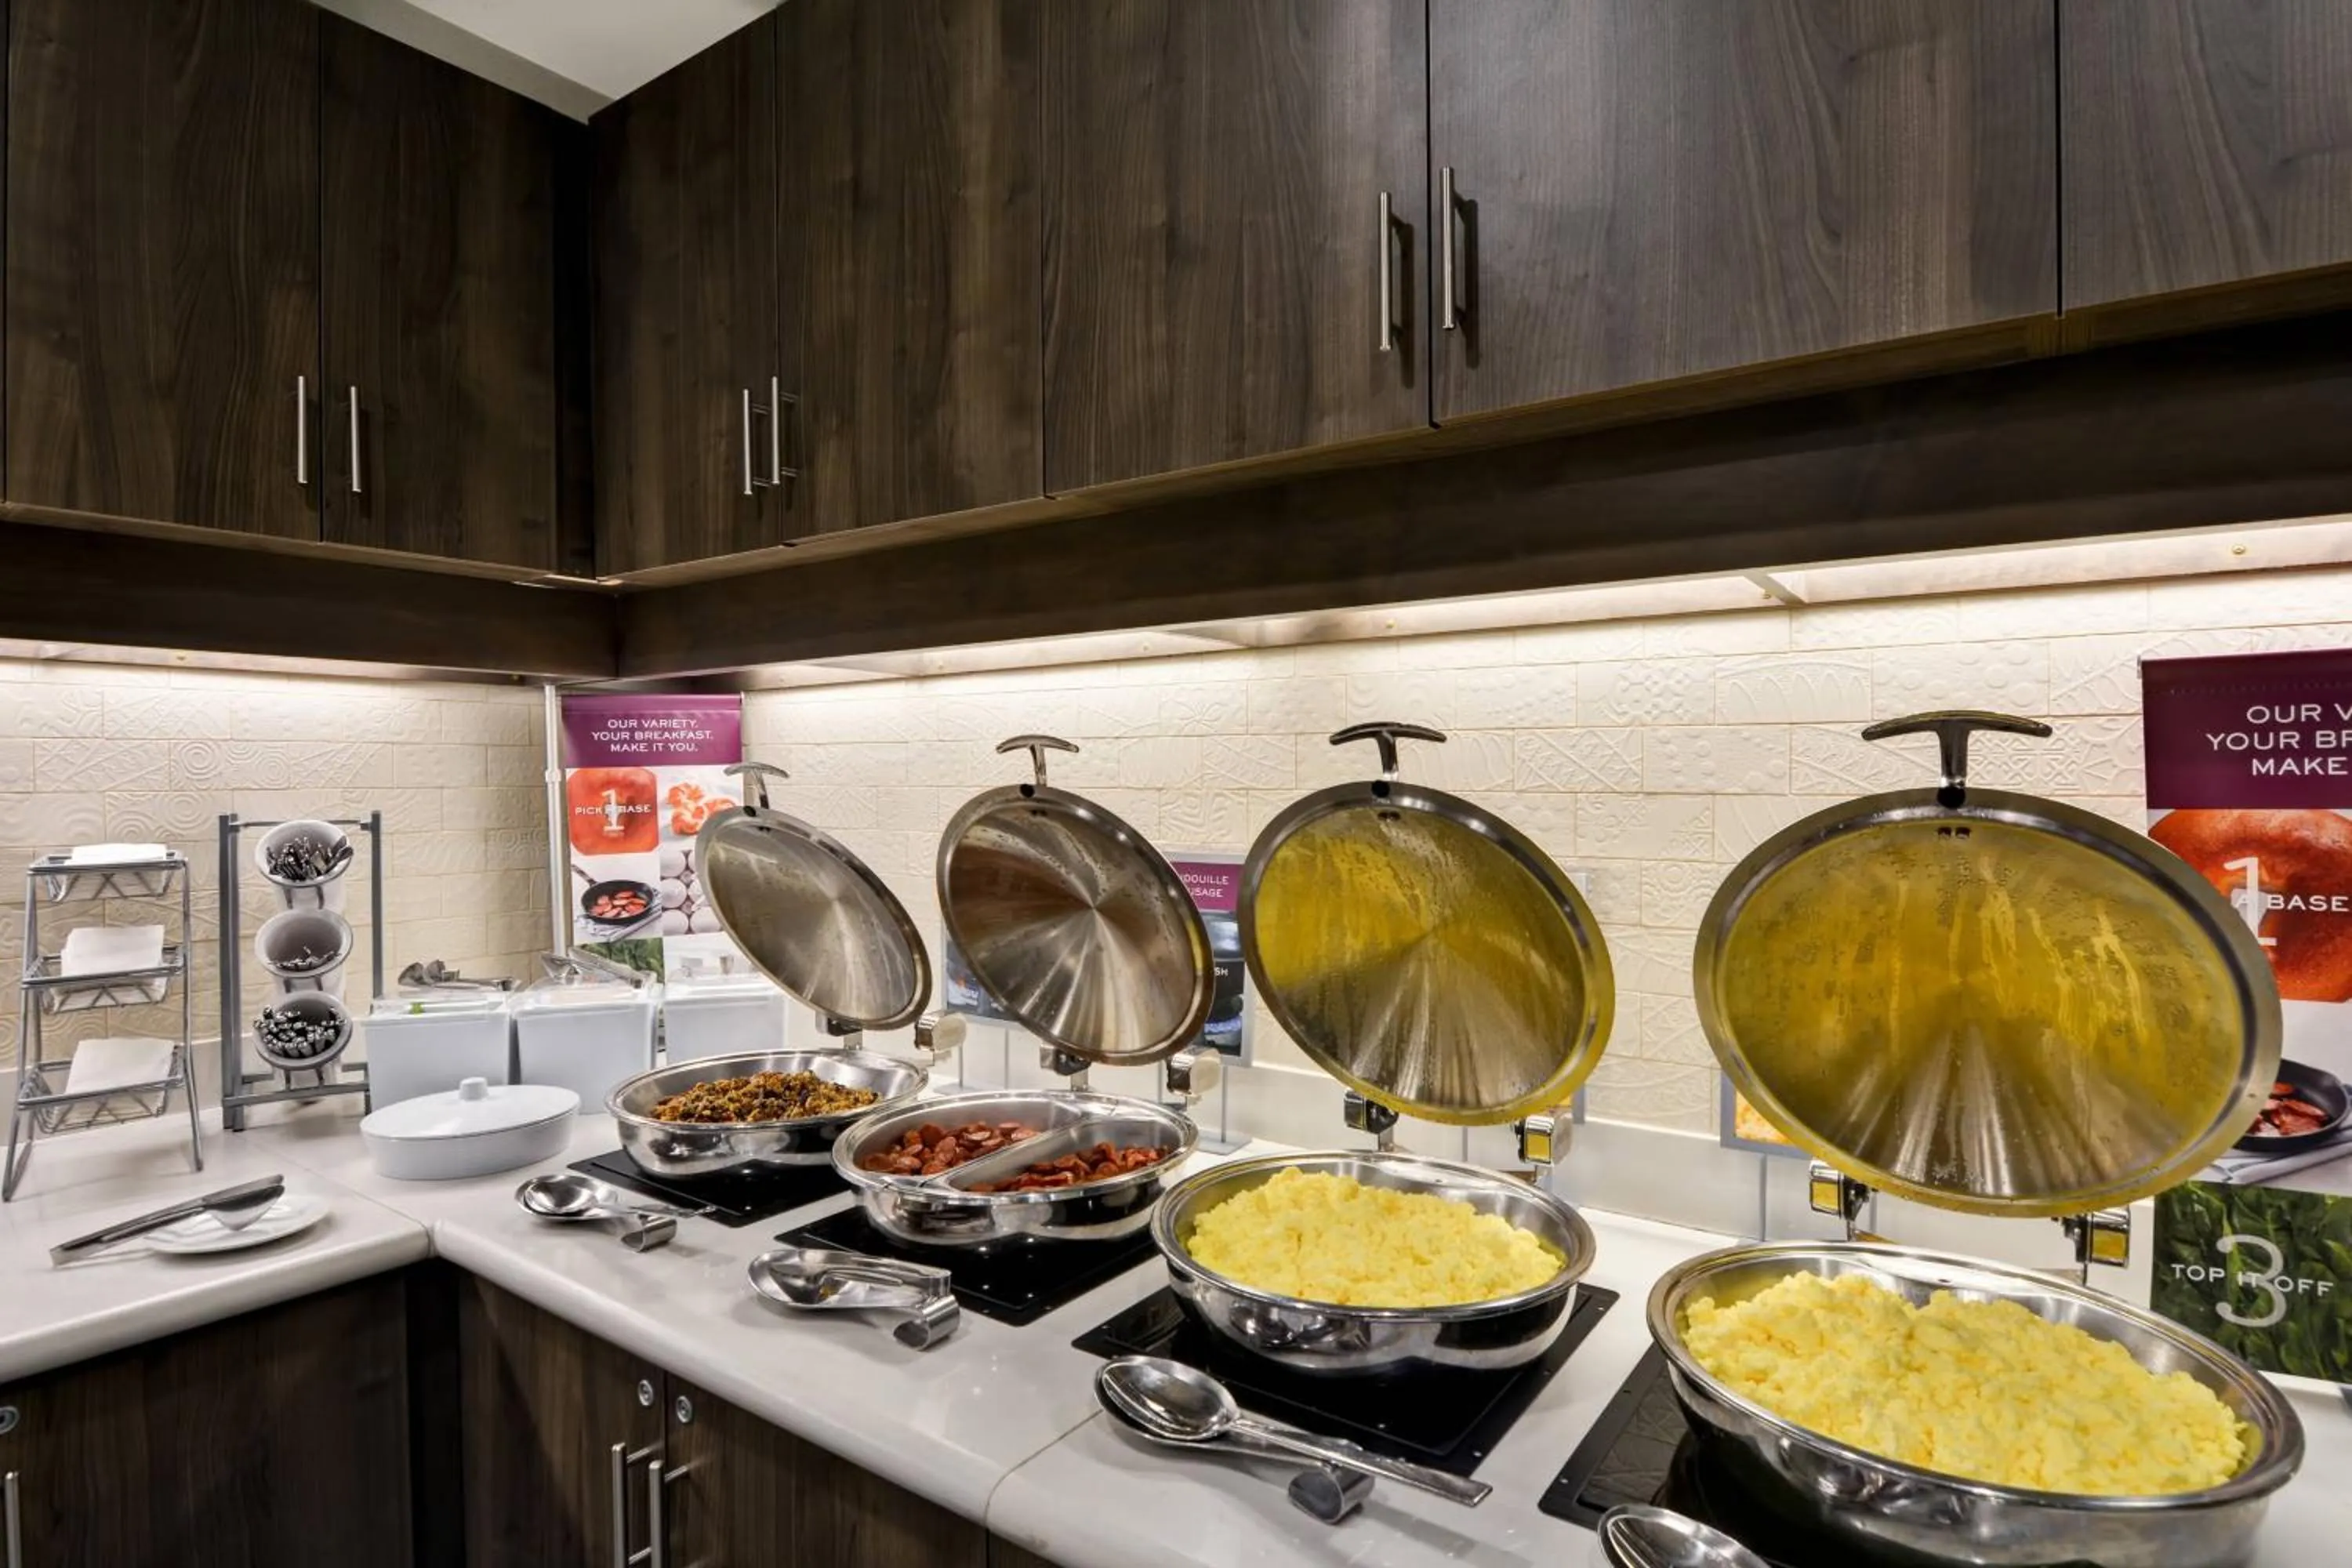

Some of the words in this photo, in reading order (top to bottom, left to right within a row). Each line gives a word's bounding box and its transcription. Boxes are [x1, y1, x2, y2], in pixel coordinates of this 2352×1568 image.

[2246, 703, 2321, 724] OUR
[608, 719, 637, 728] OUR
[641, 719, 699, 728] VARIETY.
[592, 731, 630, 741] YOUR
[634, 730, 713, 740] BREAKFAST.
[2205, 731, 2300, 751] YOUR
[610, 743, 648, 753] MAKE
[653, 742, 662, 752] IT
[668, 742, 699, 752] YOU.
[2252, 757, 2349, 775] MAKE
[575, 807, 603, 815] PICK
[617, 804, 652, 814] BASE
[601, 789, 625, 831] 1
[2223, 856, 2277, 946] 1
[2267, 895, 2350, 912] BASE
[2171, 1264, 2225, 1283] TOP
[2237, 1272, 2261, 1288] IT
[2274, 1276, 2334, 1296] OFF
[2216, 1233, 2287, 1327] 3
